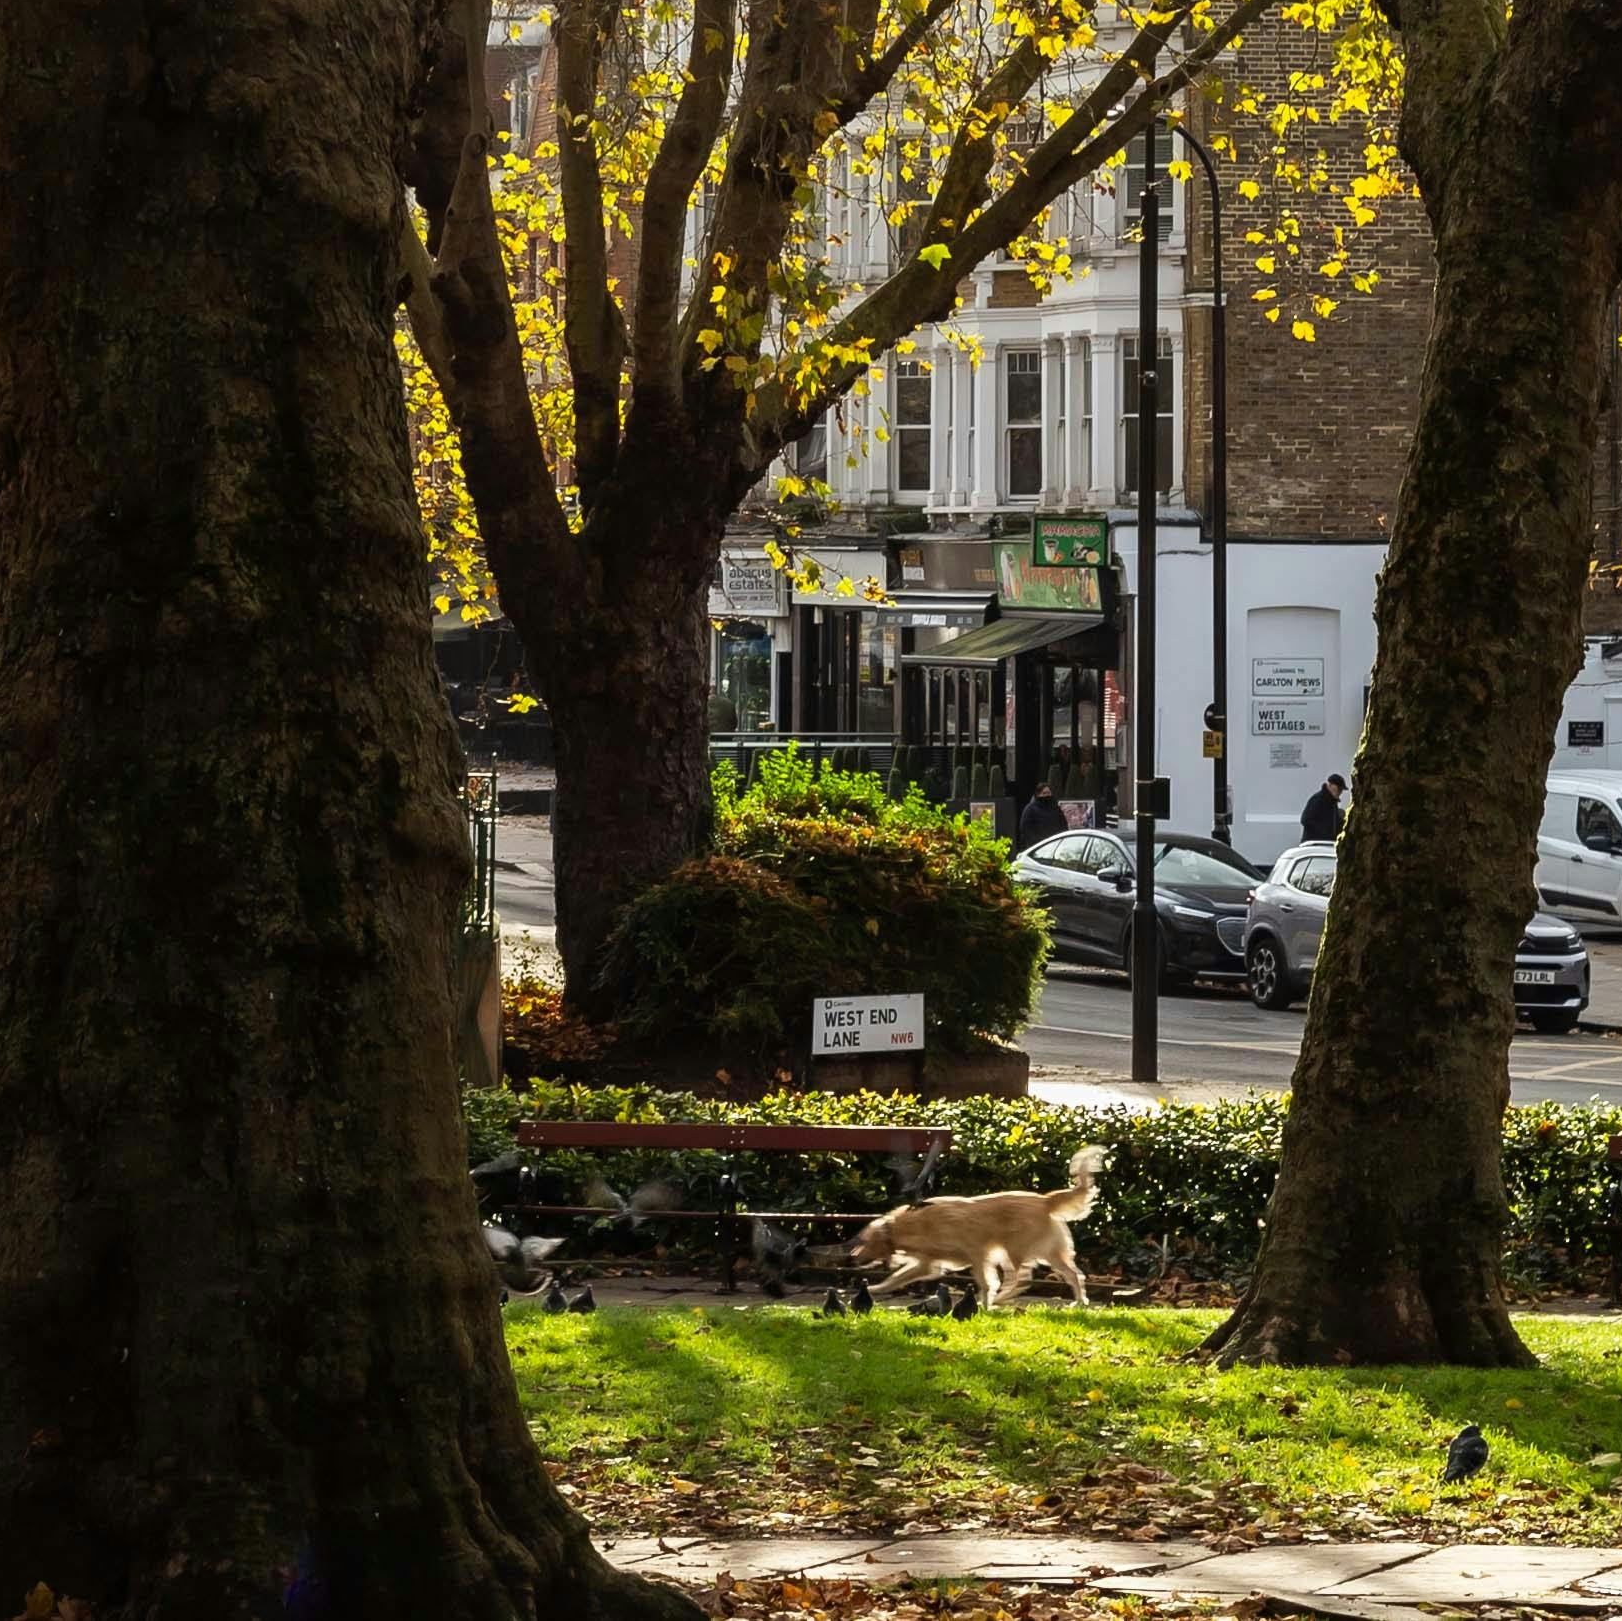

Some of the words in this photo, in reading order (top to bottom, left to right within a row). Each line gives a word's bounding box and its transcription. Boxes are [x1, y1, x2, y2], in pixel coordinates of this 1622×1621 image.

[729, 565, 772, 578] abacus
[1256, 678, 1293, 687] CARLTON
[1296, 678, 1321, 687] MEWS
[1259, 710, 1286, 720] WEST
[1258, 721, 1306, 731] COTTAGES
[1515, 971, 1533, 982] E73
[825, 1010, 864, 1028] WEST
[869, 1008, 898, 1025] END
[824, 1031, 861, 1048] LANE
[890, 1032, 914, 1045] NW6
